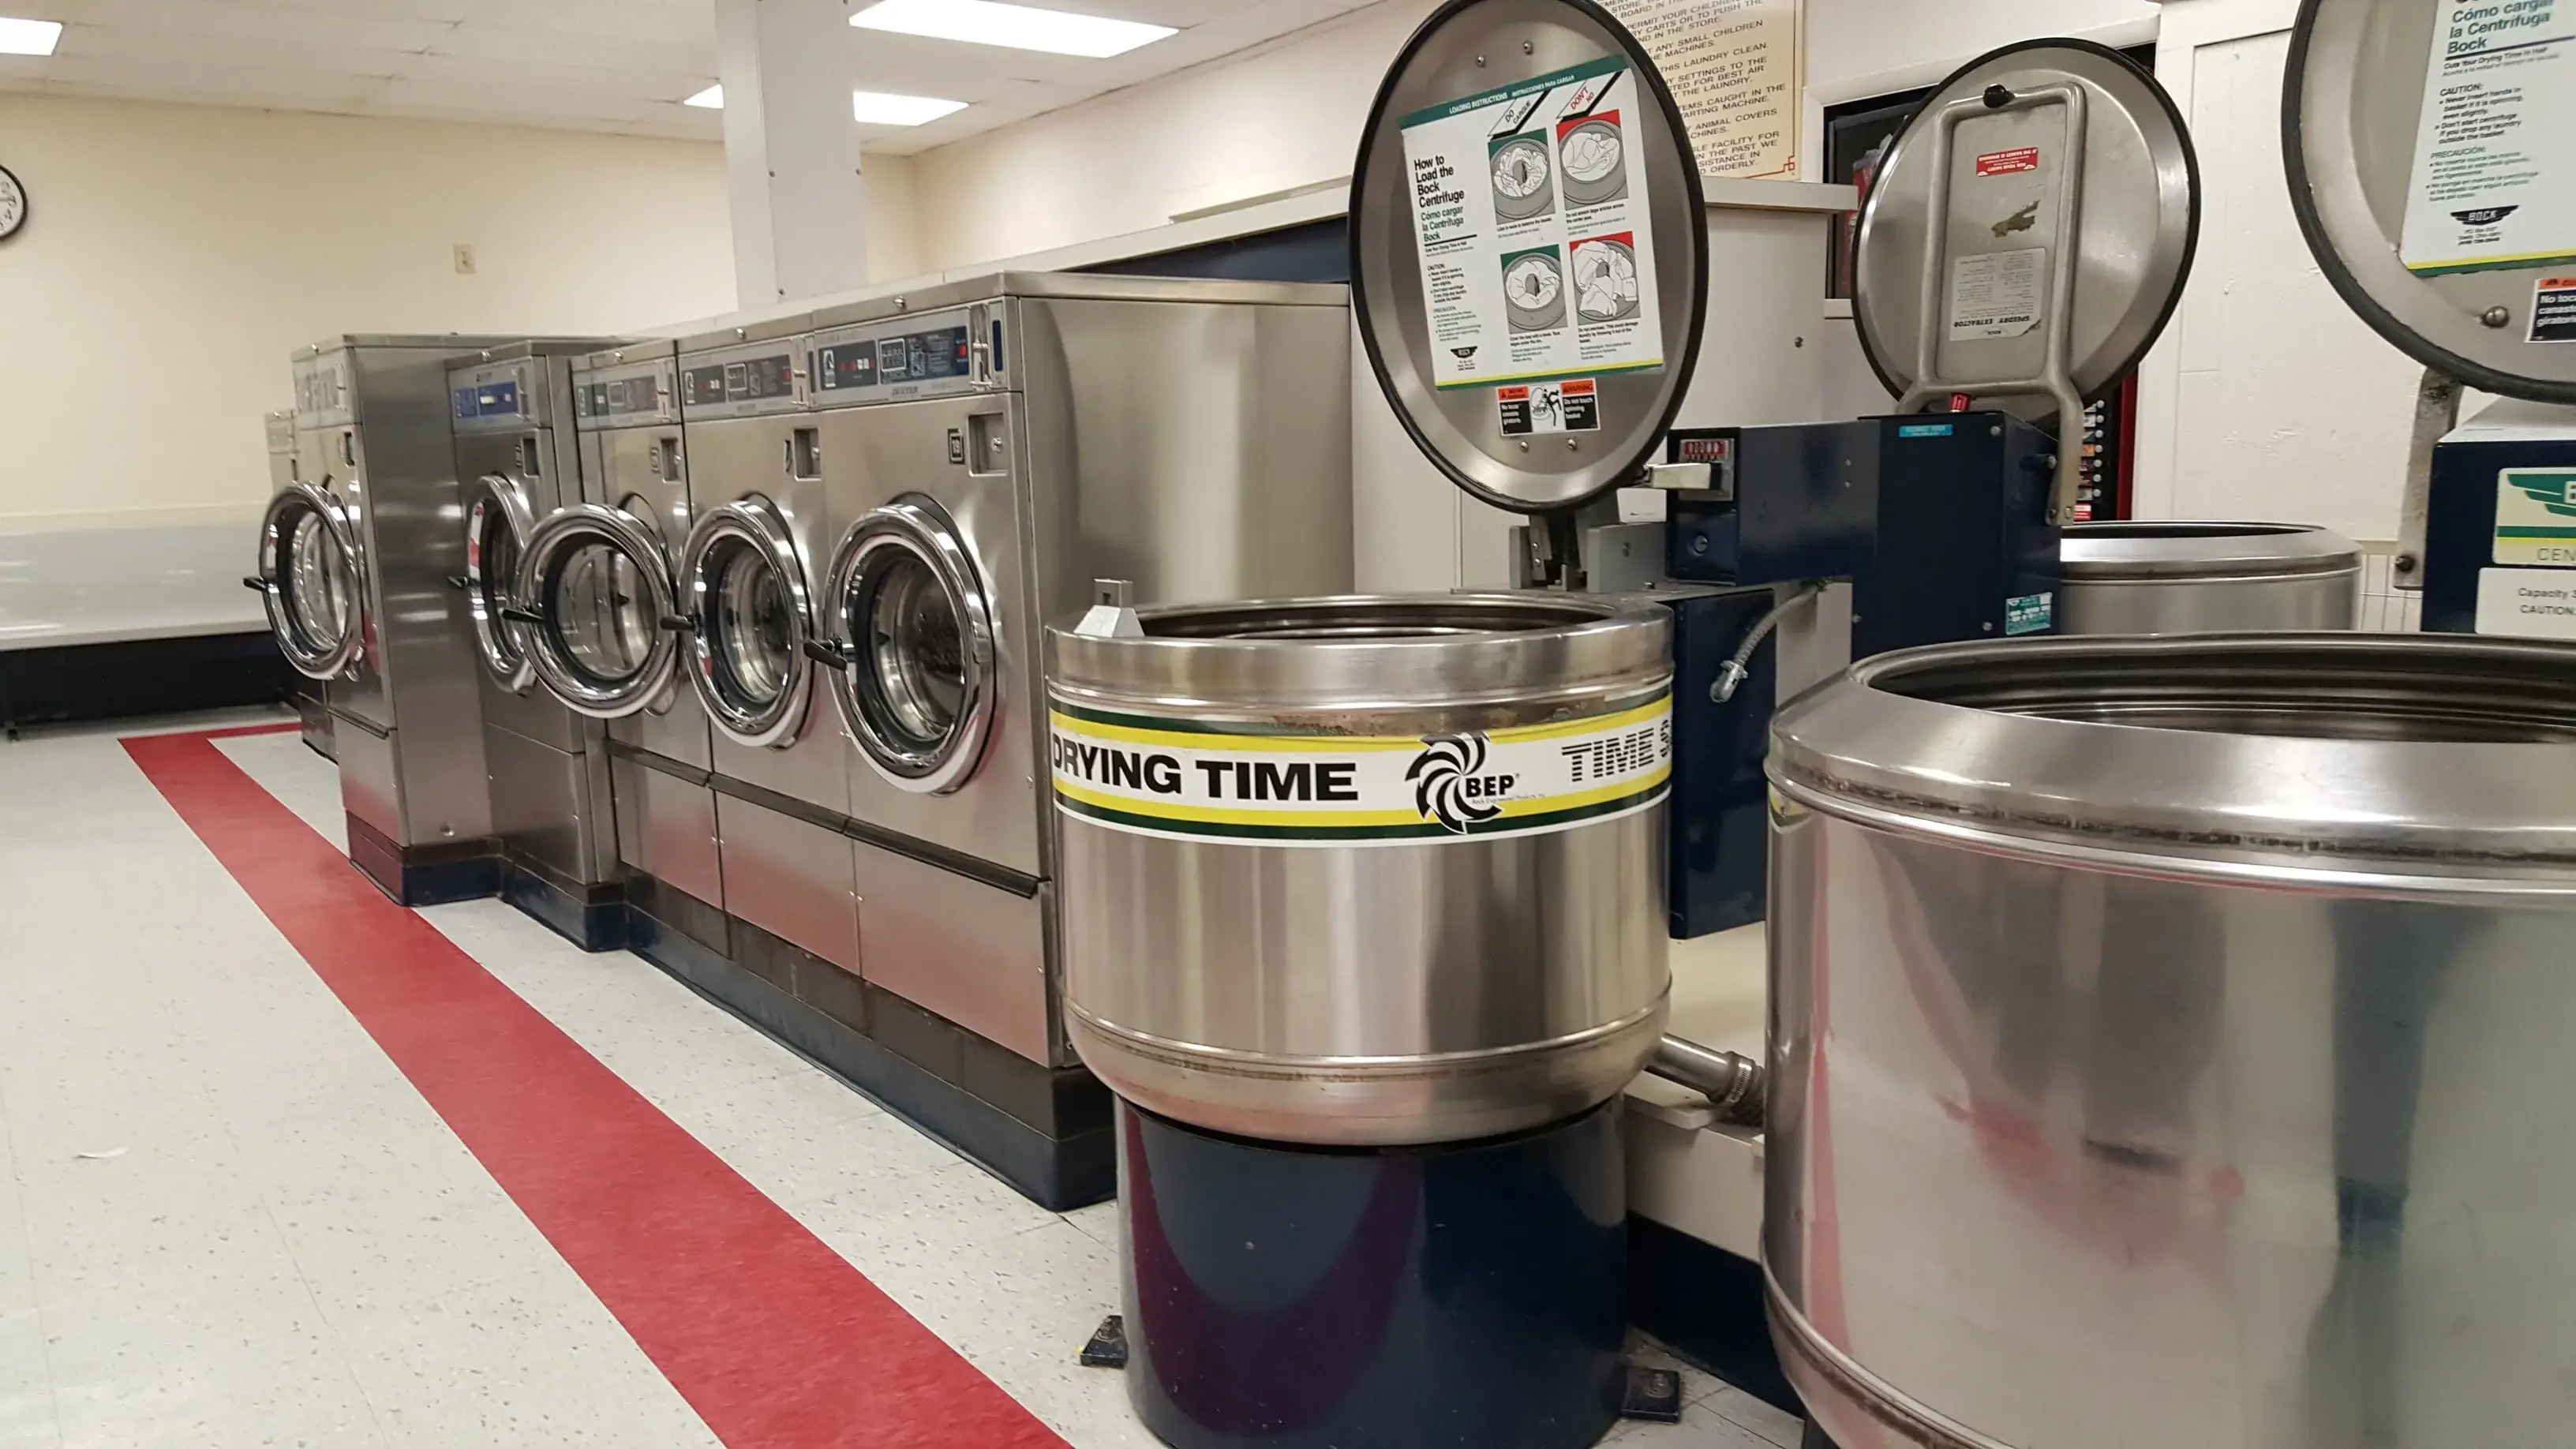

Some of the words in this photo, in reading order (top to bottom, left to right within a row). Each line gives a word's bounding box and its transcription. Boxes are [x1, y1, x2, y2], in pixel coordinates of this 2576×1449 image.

[1620, 6, 1652, 18] BOARD
[1646, 21, 1676, 33] CARTS
[1714, 3, 1741, 16] PUSH
[1662, 9, 1687, 21] YOUR
[2452, 6, 2499, 23] Cómo
[1668, 26, 1683, 36] THE
[2449, 27, 2462, 39] la
[2467, 11, 2552, 28] Centrífuga
[1656, 43, 1674, 53] ANY
[1678, 33, 1709, 47] SMALL
[1713, 20, 1763, 37] CHILDREN
[2447, 37, 2488, 54] Bock
[1660, 63, 1680, 73] THIS
[1684, 51, 1729, 68] LAUNDRY
[1733, 42, 1769, 55] CLEAN.
[2478, 54, 2503, 64] Drying
[1678, 65, 1726, 82] SETTINGS
[1732, 62, 1743, 70] TO
[1748, 56, 1768, 66] THE
[1694, 77, 1714, 86] FOR
[1718, 70, 1743, 80] BEST
[1748, 65, 1764, 75] AIR
[1544, 79, 1557, 89] PARA
[1556, 74, 1575, 86] CARGAR
[1683, 88, 1700, 97] THE
[1704, 77, 1753, 92] LAUNDRY.
[2440, 83, 2484, 96] CAUTION:
[1570, 86, 1589, 110] DON'T
[1586, 92, 1596, 104] NO
[1708, 93, 1747, 106] CAUGHT
[1766, 83, 1787, 94] THE
[1723, 94, 1771, 110] MACHINE.
[1449, 102, 1471, 115] LOADING
[1471, 92, 1508, 109] INSTRUCTIONS
[1504, 109, 1515, 123] DO
[1695, 118, 1731, 130] ANIMAL
[1735, 108, 1778, 122] COVERS
[1712, 136, 1754, 149] FACILITY
[1758, 131, 1780, 142] FOR
[1711, 150, 1726, 159] THE
[1732, 142, 1757, 155] PAST
[1761, 139, 1778, 149] WE
[1750, 150, 1761, 159] IN
[1414, 159, 1433, 171] How
[1436, 155, 1444, 166] to
[1710, 159, 1759, 174] ORDERLY.
[1416, 169, 1438, 183] Load
[1439, 167, 1454, 178] the
[1417, 181, 1441, 195] Bock
[1419, 190, 1465, 208] Centrifuge
[1421, 209, 1441, 222] Cómo
[1442, 206, 1464, 218] cargar
[2468, 210, 2497, 222] BOCK
[1422, 223, 1428, 232] la
[1424, 231, 1441, 242] Bock
[2540, 294, 2556, 304] No
[1953, 318, 1994, 328] EXTRACTOR
[2518, 586, 2569, 603] Capacity
[1562, 728, 1655, 782] TIME
[1053, 732, 1182, 795] DRYING
[1196, 760, 1359, 801] TIME
[1466, 774, 1515, 798] BEP
